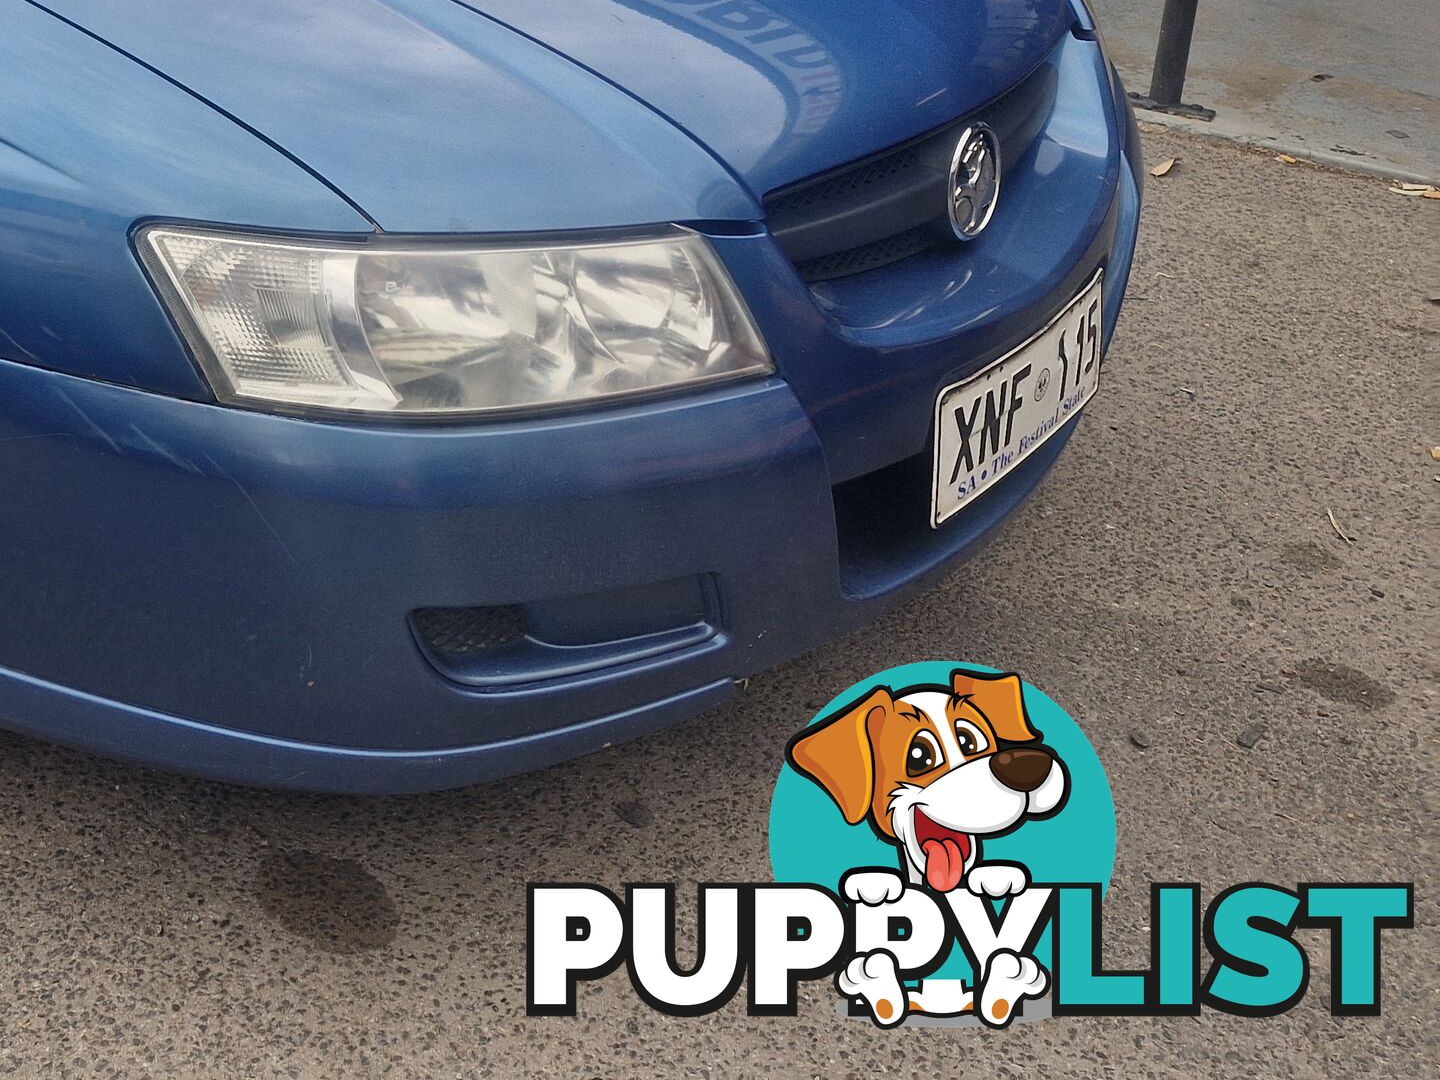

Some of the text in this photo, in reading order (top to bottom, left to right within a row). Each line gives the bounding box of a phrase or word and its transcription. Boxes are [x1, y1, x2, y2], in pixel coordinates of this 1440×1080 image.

[949, 363, 1032, 485] XNF
[957, 386, 1086, 500] SA The Festival State
